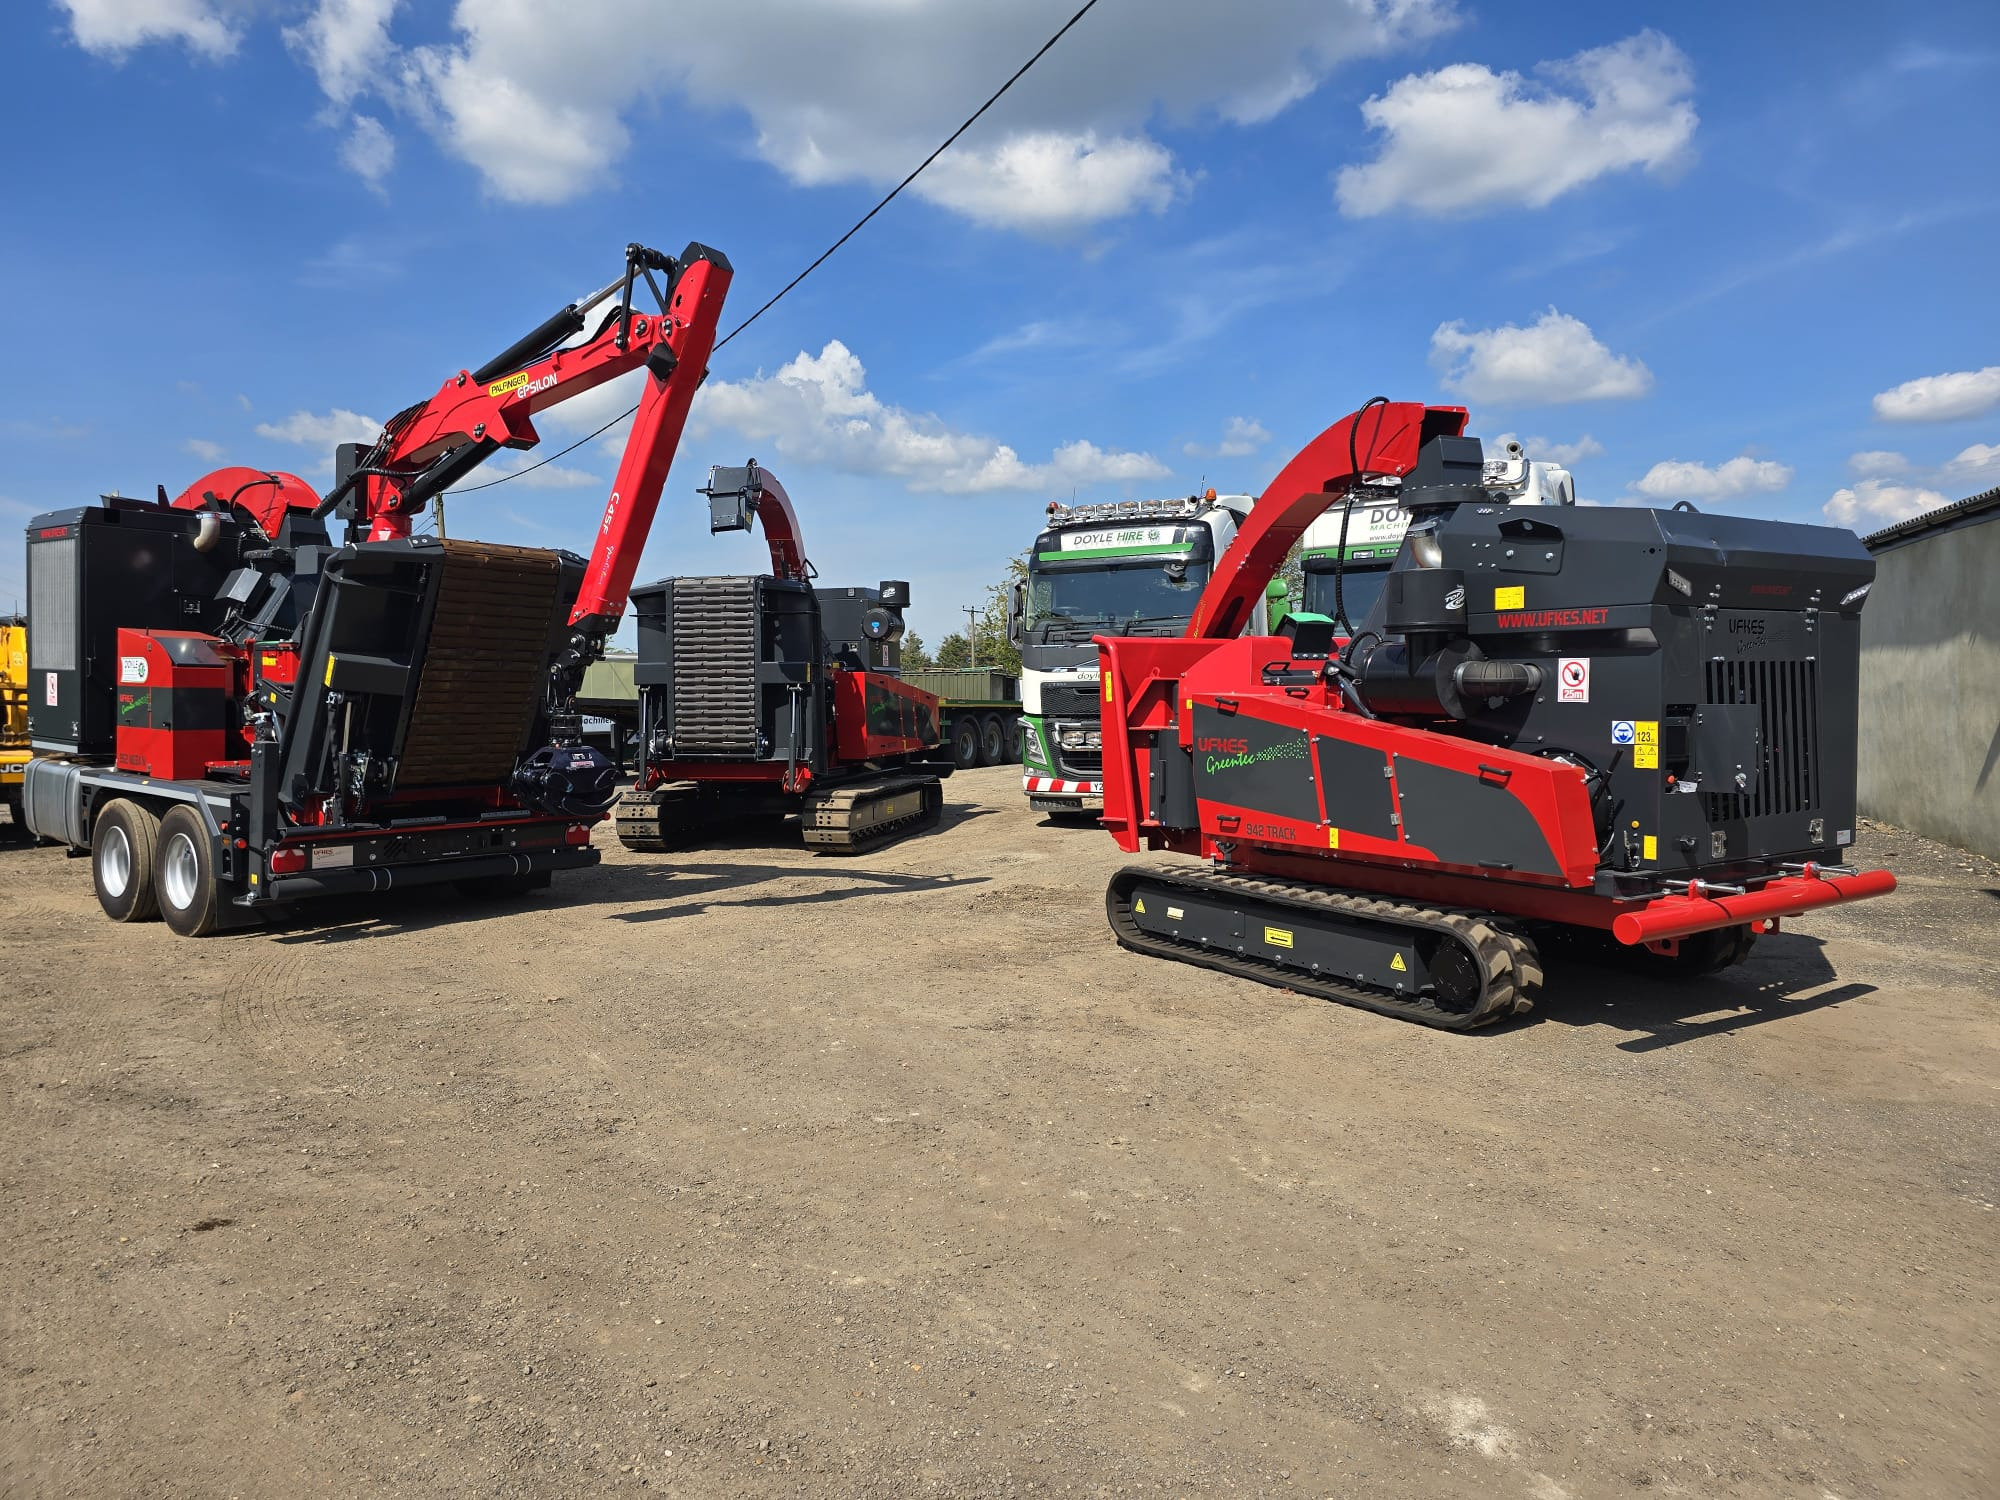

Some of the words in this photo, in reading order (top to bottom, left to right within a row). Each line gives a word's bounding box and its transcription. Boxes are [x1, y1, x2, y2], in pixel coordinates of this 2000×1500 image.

[491, 375, 526, 394] PALFINGER
[517, 372, 558, 399] EPSILON
[1073, 532, 1113, 545] DOYLE
[1117, 531, 1144, 542] HIRE
[1498, 609, 1608, 629] WWW.UFKES.NET
[1729, 619, 1765, 634] UFKES
[1564, 690, 1584, 699] 25m
[1198, 737, 1248, 753] UFKES
[1637, 731, 1651, 742] 123
[1206, 751, 1256, 775] Greentec
[1246, 823, 1265, 837] 942
[1267, 825, 1297, 841] TRACK
